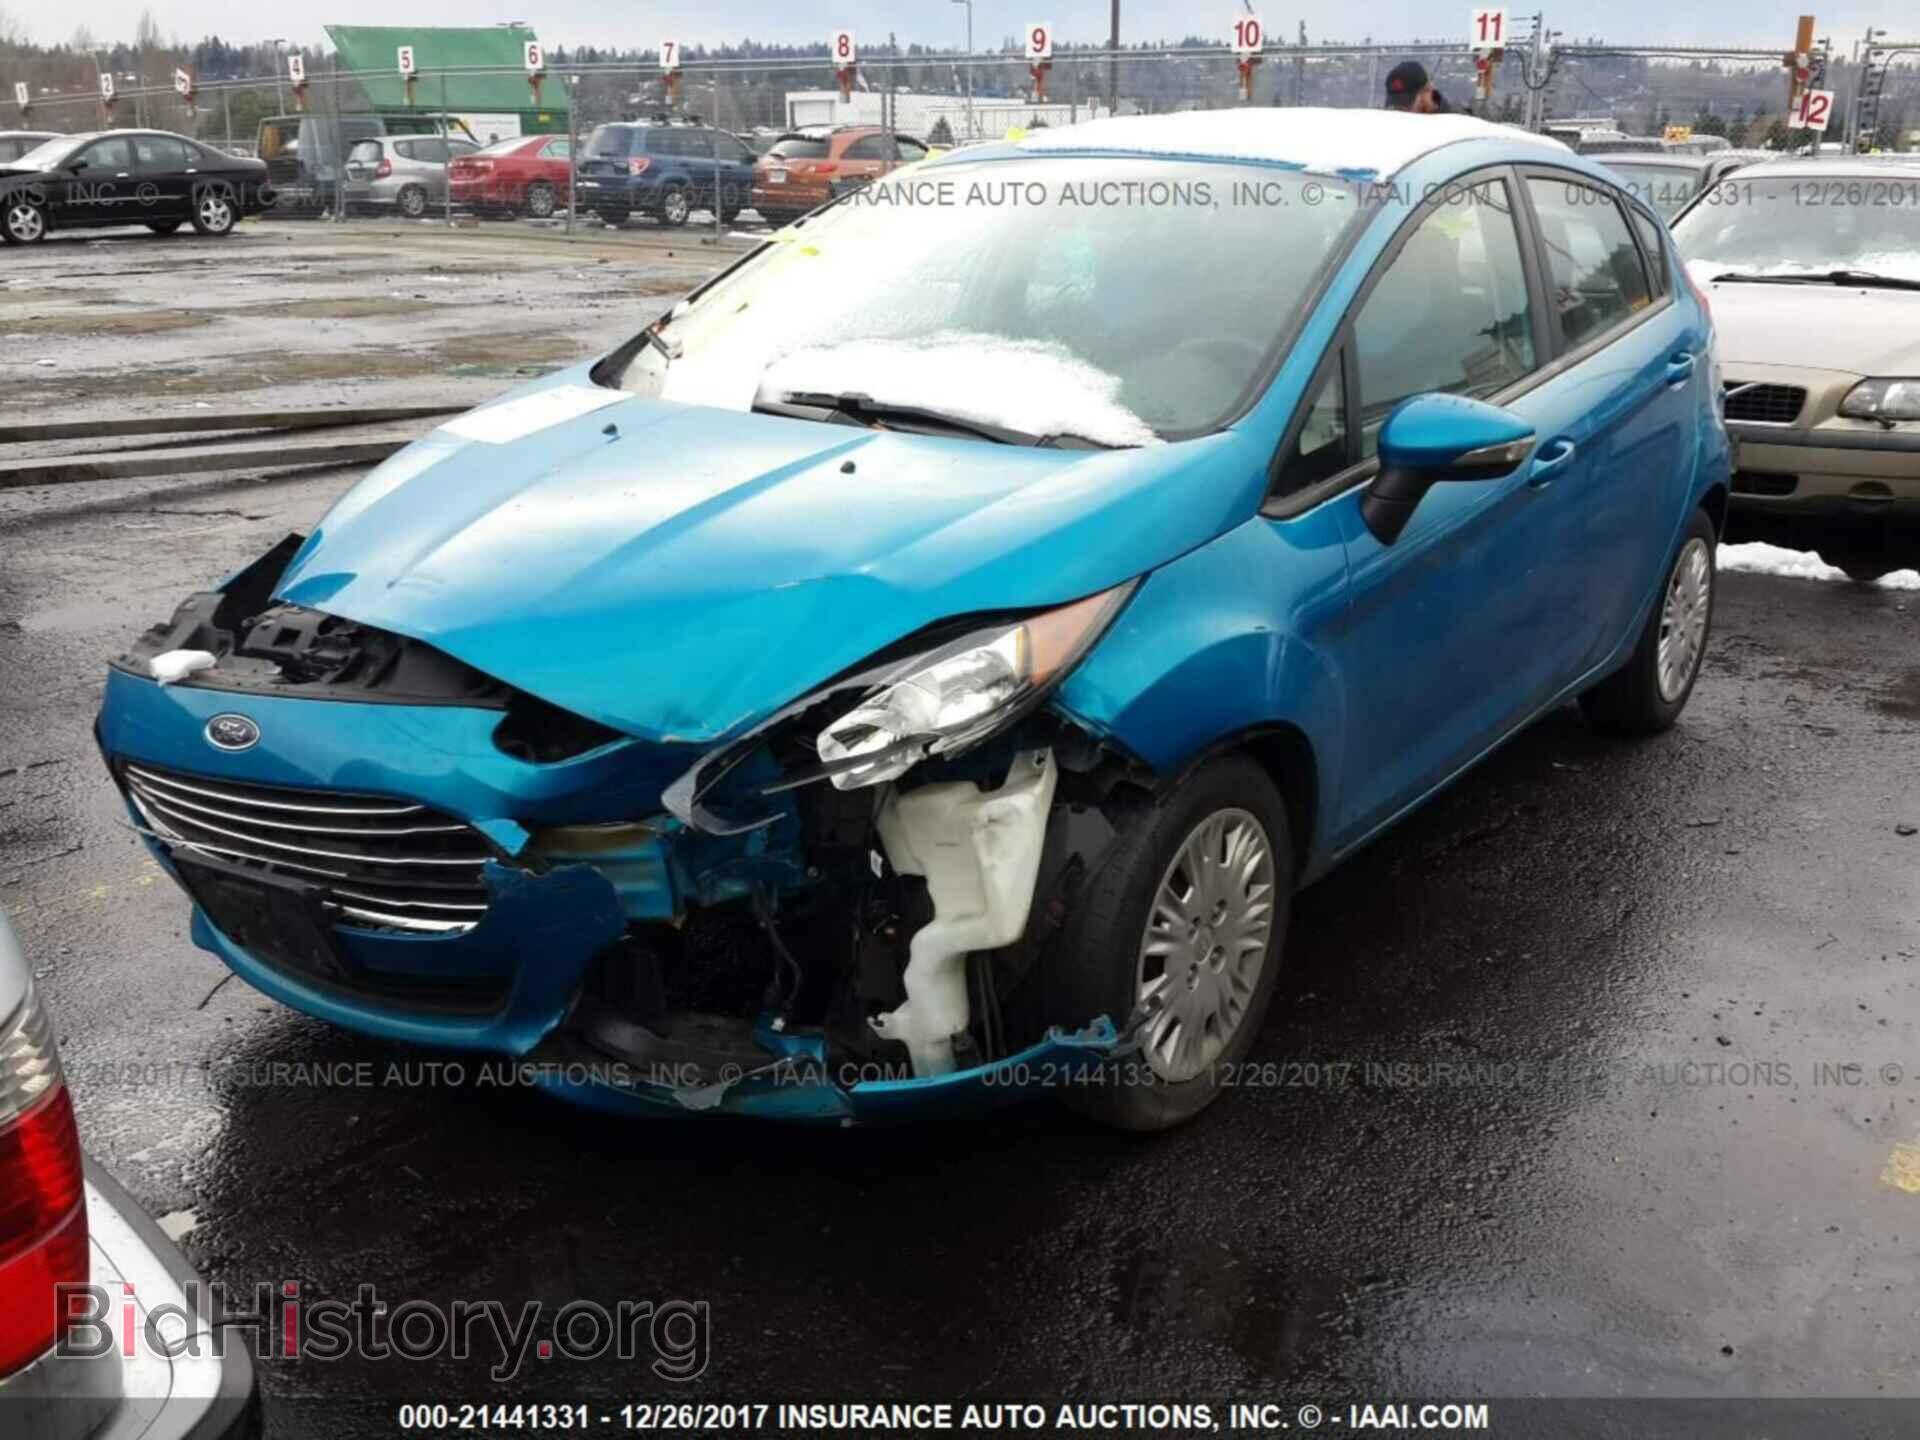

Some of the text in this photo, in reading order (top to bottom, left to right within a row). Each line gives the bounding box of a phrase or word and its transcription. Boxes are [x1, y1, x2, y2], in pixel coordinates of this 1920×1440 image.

[1234, 20, 1260, 48] 10
[1476, 12, 1502, 42] 11
[663, 42, 675, 62] 7
[838, 34, 849, 58] 8
[1032, 28, 1045, 53] 9
[401, 50, 411, 70] 5
[528, 44, 538, 65] 6
[292, 59, 301, 75] 4
[1799, 95, 1829, 124] 12
